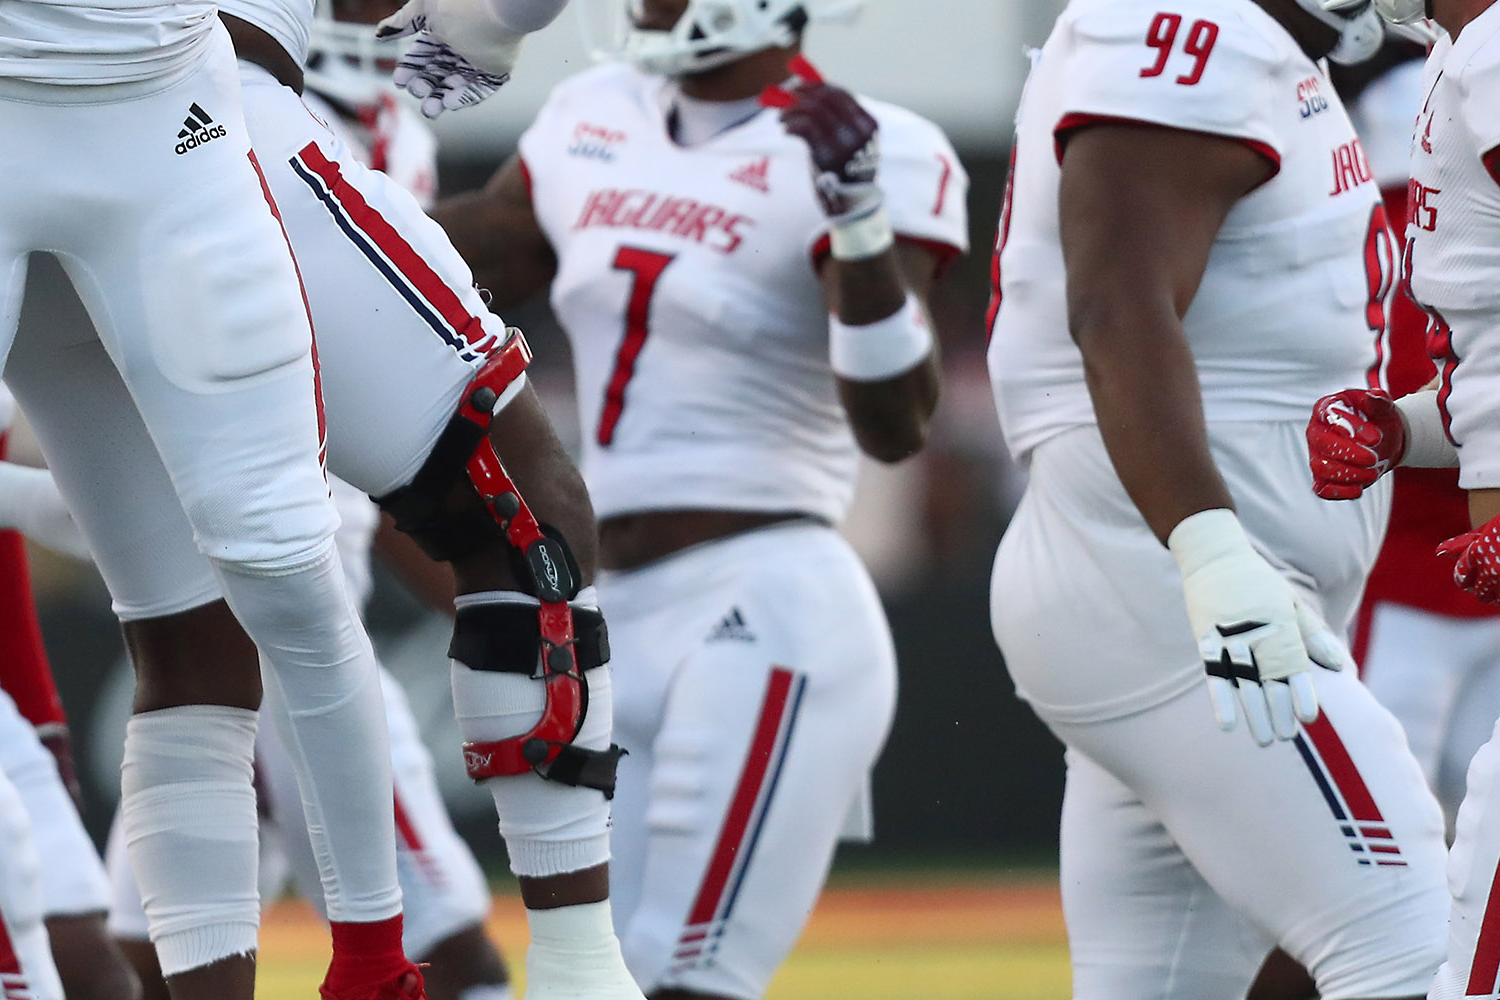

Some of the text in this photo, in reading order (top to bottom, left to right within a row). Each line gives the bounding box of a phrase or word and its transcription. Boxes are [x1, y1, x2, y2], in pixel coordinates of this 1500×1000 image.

[1138, 11, 1219, 86] 99
[175, 124, 226, 155] adidas
[573, 190, 754, 254] JAGUARS
